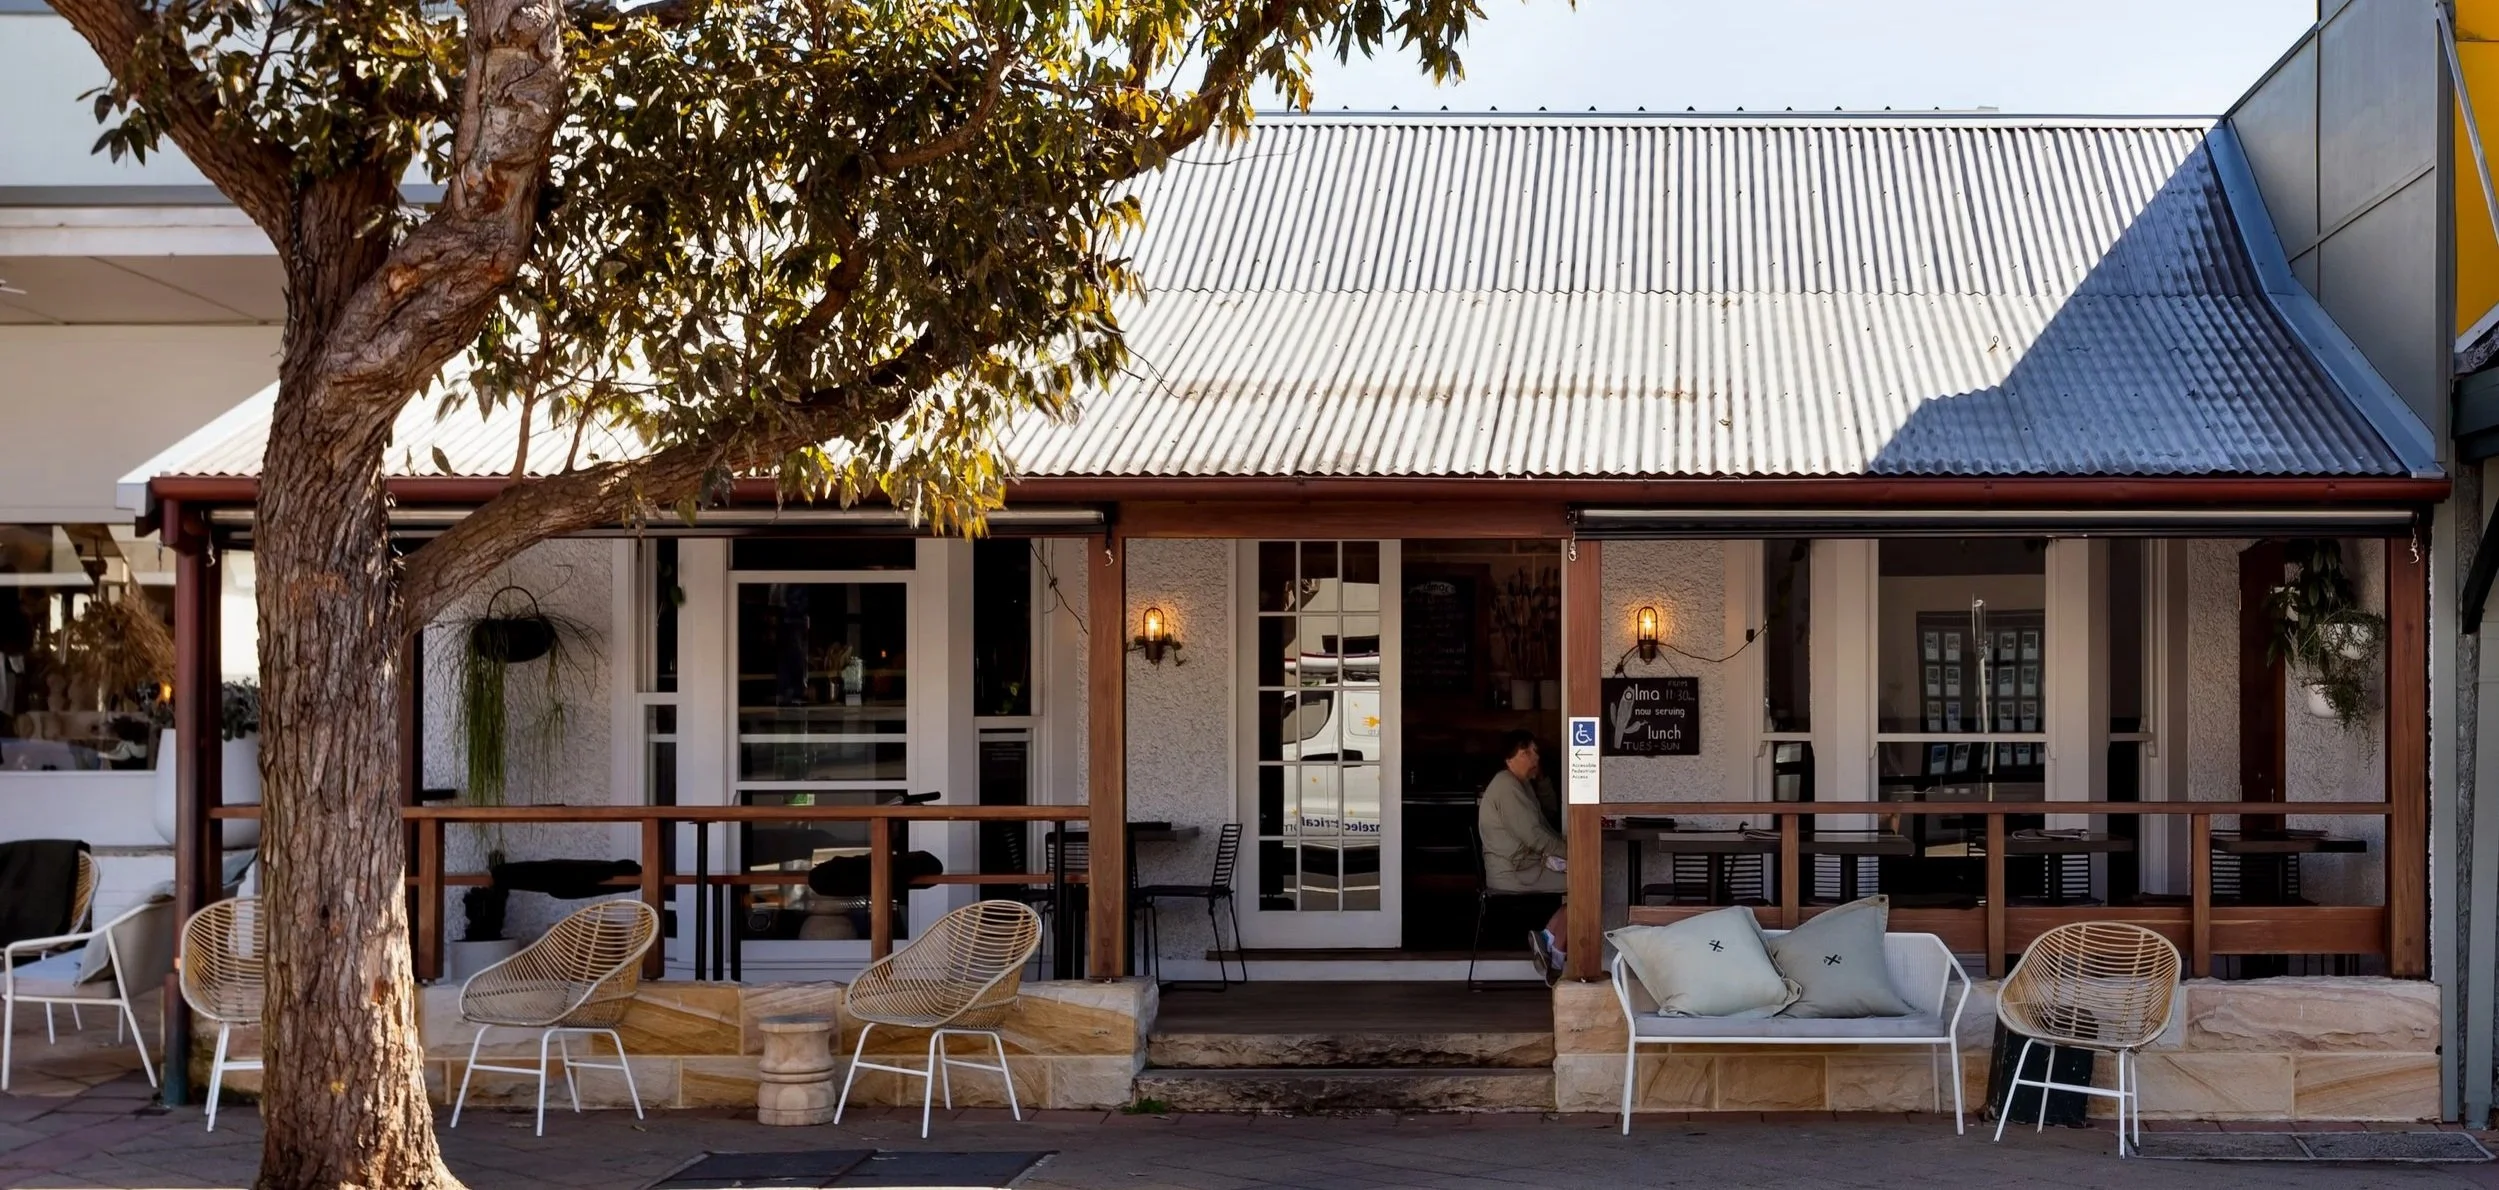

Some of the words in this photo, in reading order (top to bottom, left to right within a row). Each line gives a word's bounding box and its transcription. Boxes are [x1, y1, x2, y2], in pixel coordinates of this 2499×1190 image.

[1635, 708, 1652, 716] now
[1655, 707, 1685, 718] serving
[1648, 724, 1681, 739] lunch
